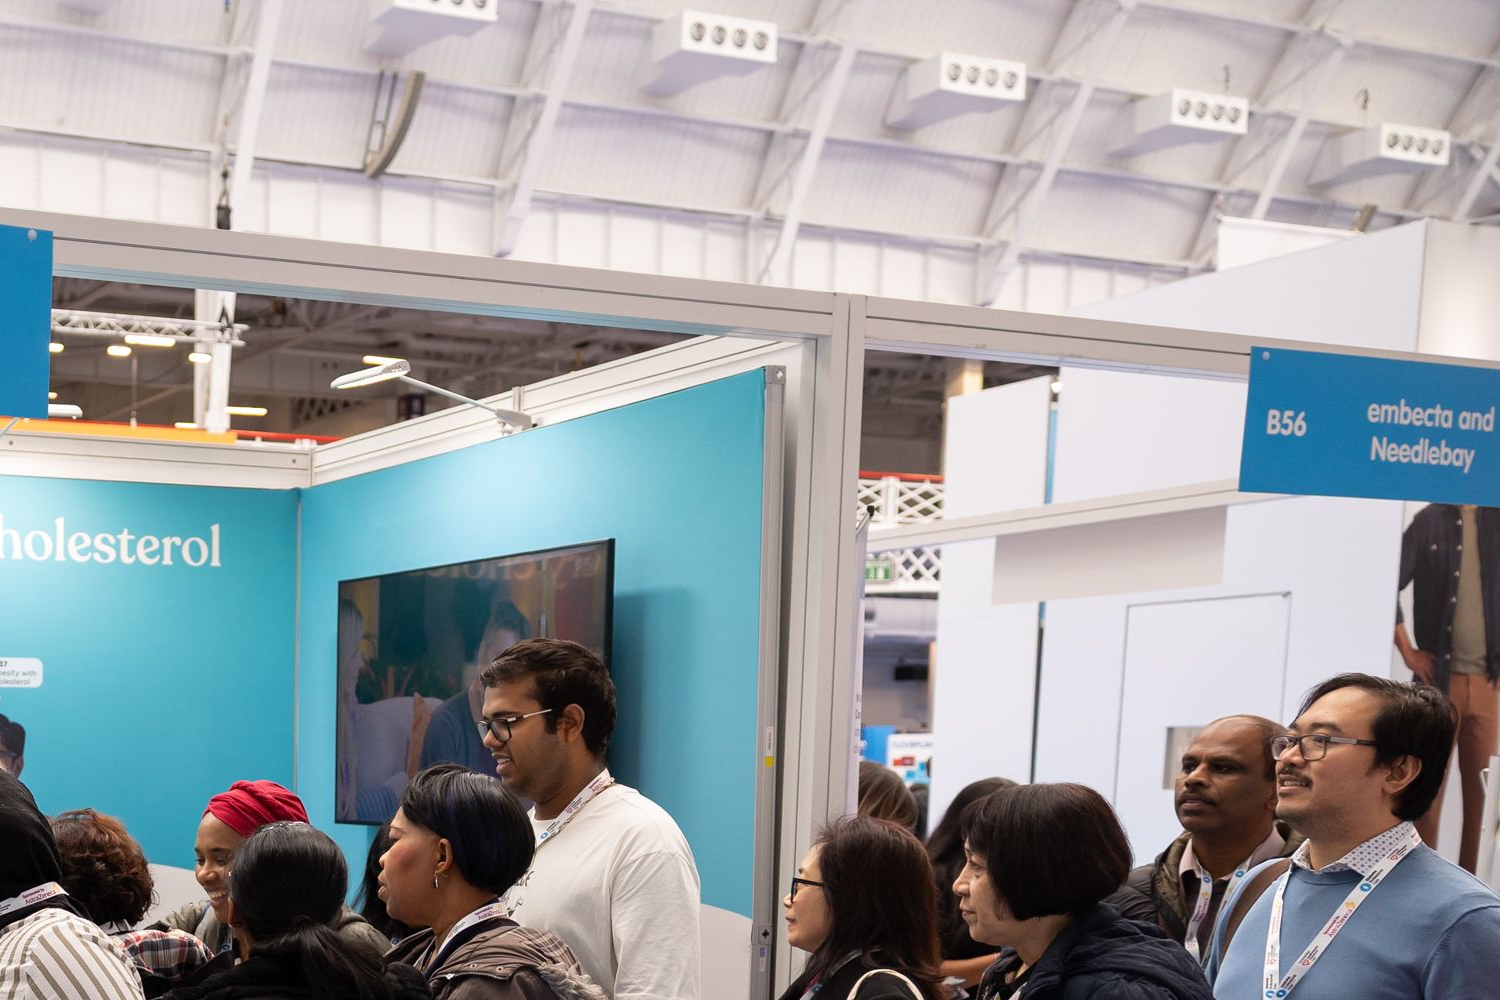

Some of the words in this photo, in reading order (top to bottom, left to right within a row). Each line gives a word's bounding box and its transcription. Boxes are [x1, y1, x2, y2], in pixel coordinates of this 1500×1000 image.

[1266, 409, 1307, 437] B56
[1367, 399, 1452, 428] embecta
[1458, 406, 1495, 432] and
[1370, 436, 1475, 474] Needlebay
[21, 669, 37, 677] with
